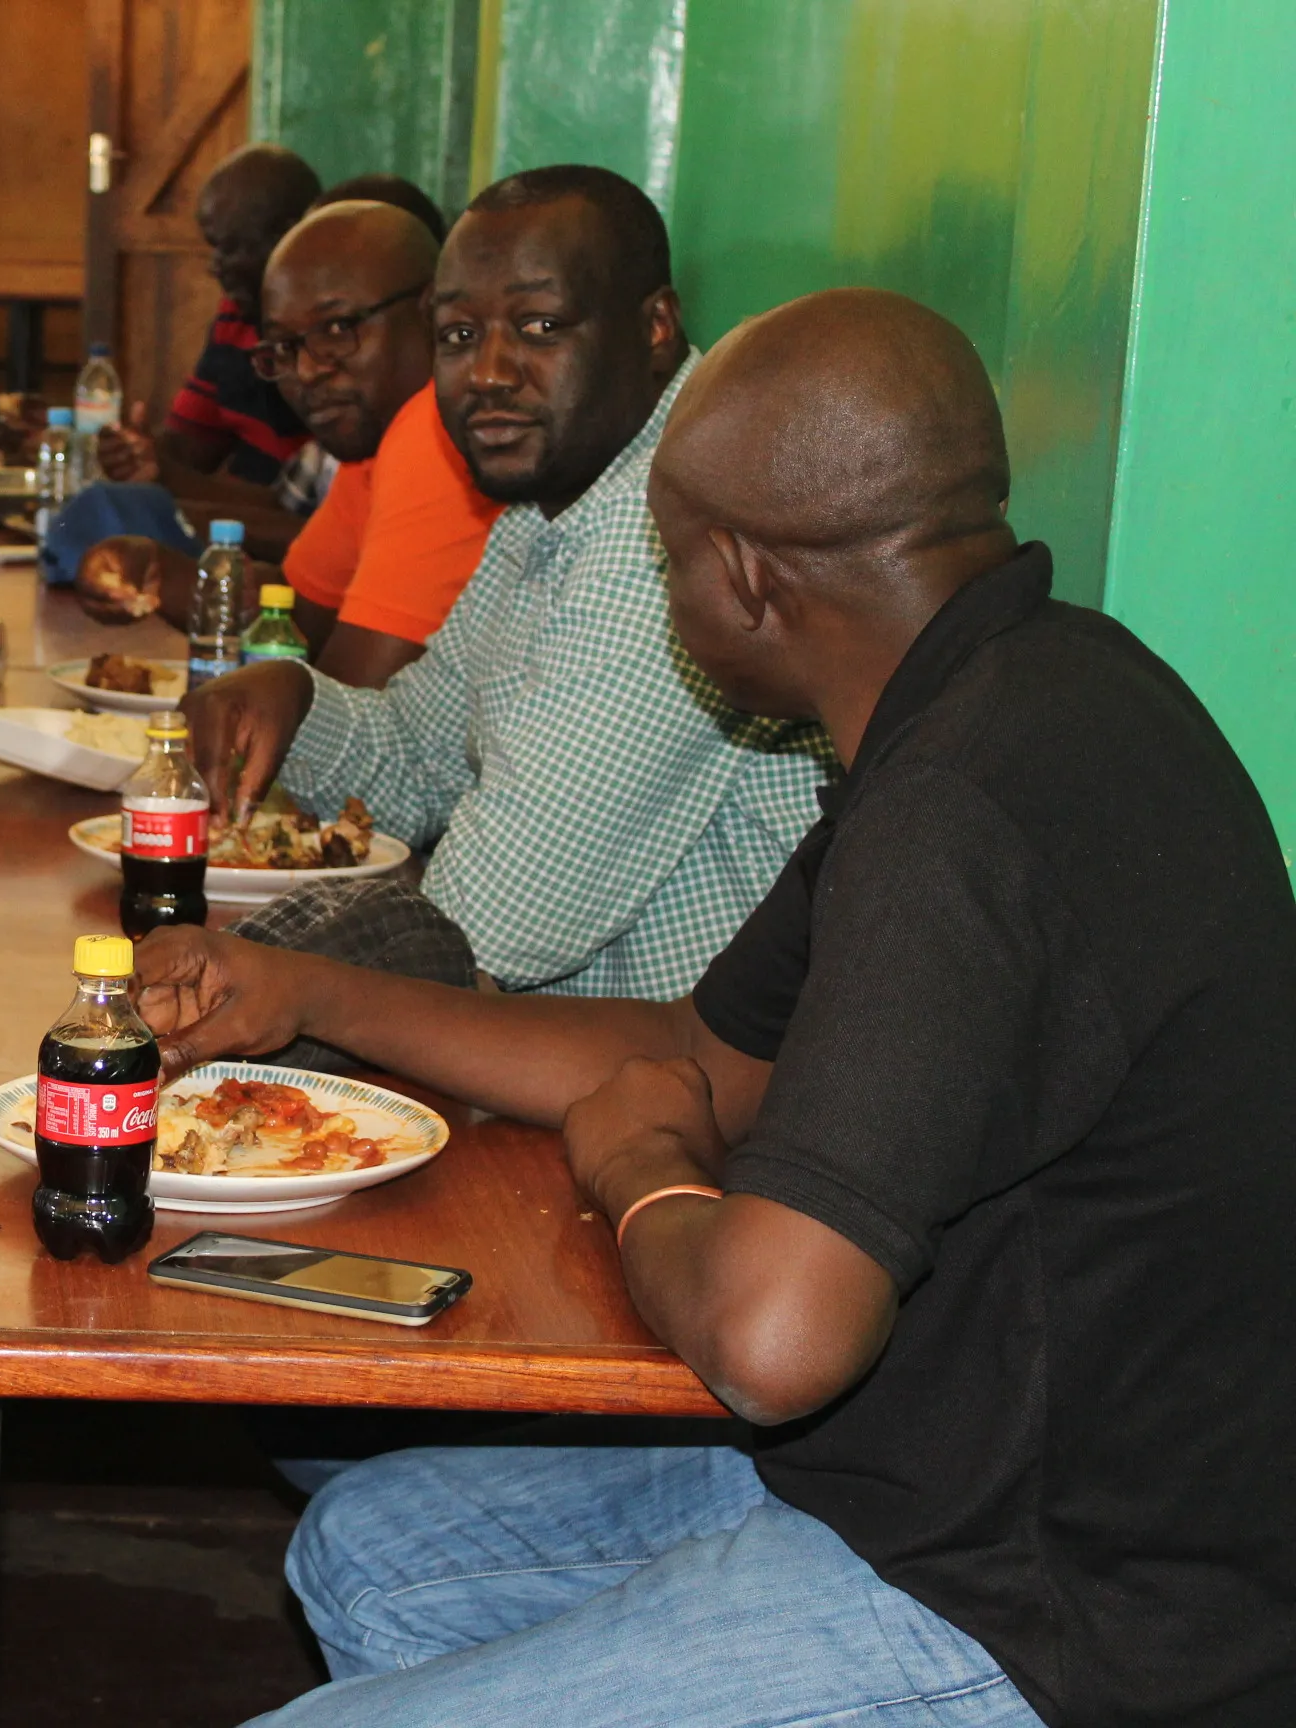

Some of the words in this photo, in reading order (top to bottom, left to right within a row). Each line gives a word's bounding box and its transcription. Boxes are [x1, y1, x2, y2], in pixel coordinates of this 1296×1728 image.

[133, 1089, 153, 1097] ORIGINAL
[89, 1103, 97, 1120] DRINK
[97, 1126, 110, 1138] 350
[110, 1126, 119, 1138] ml
